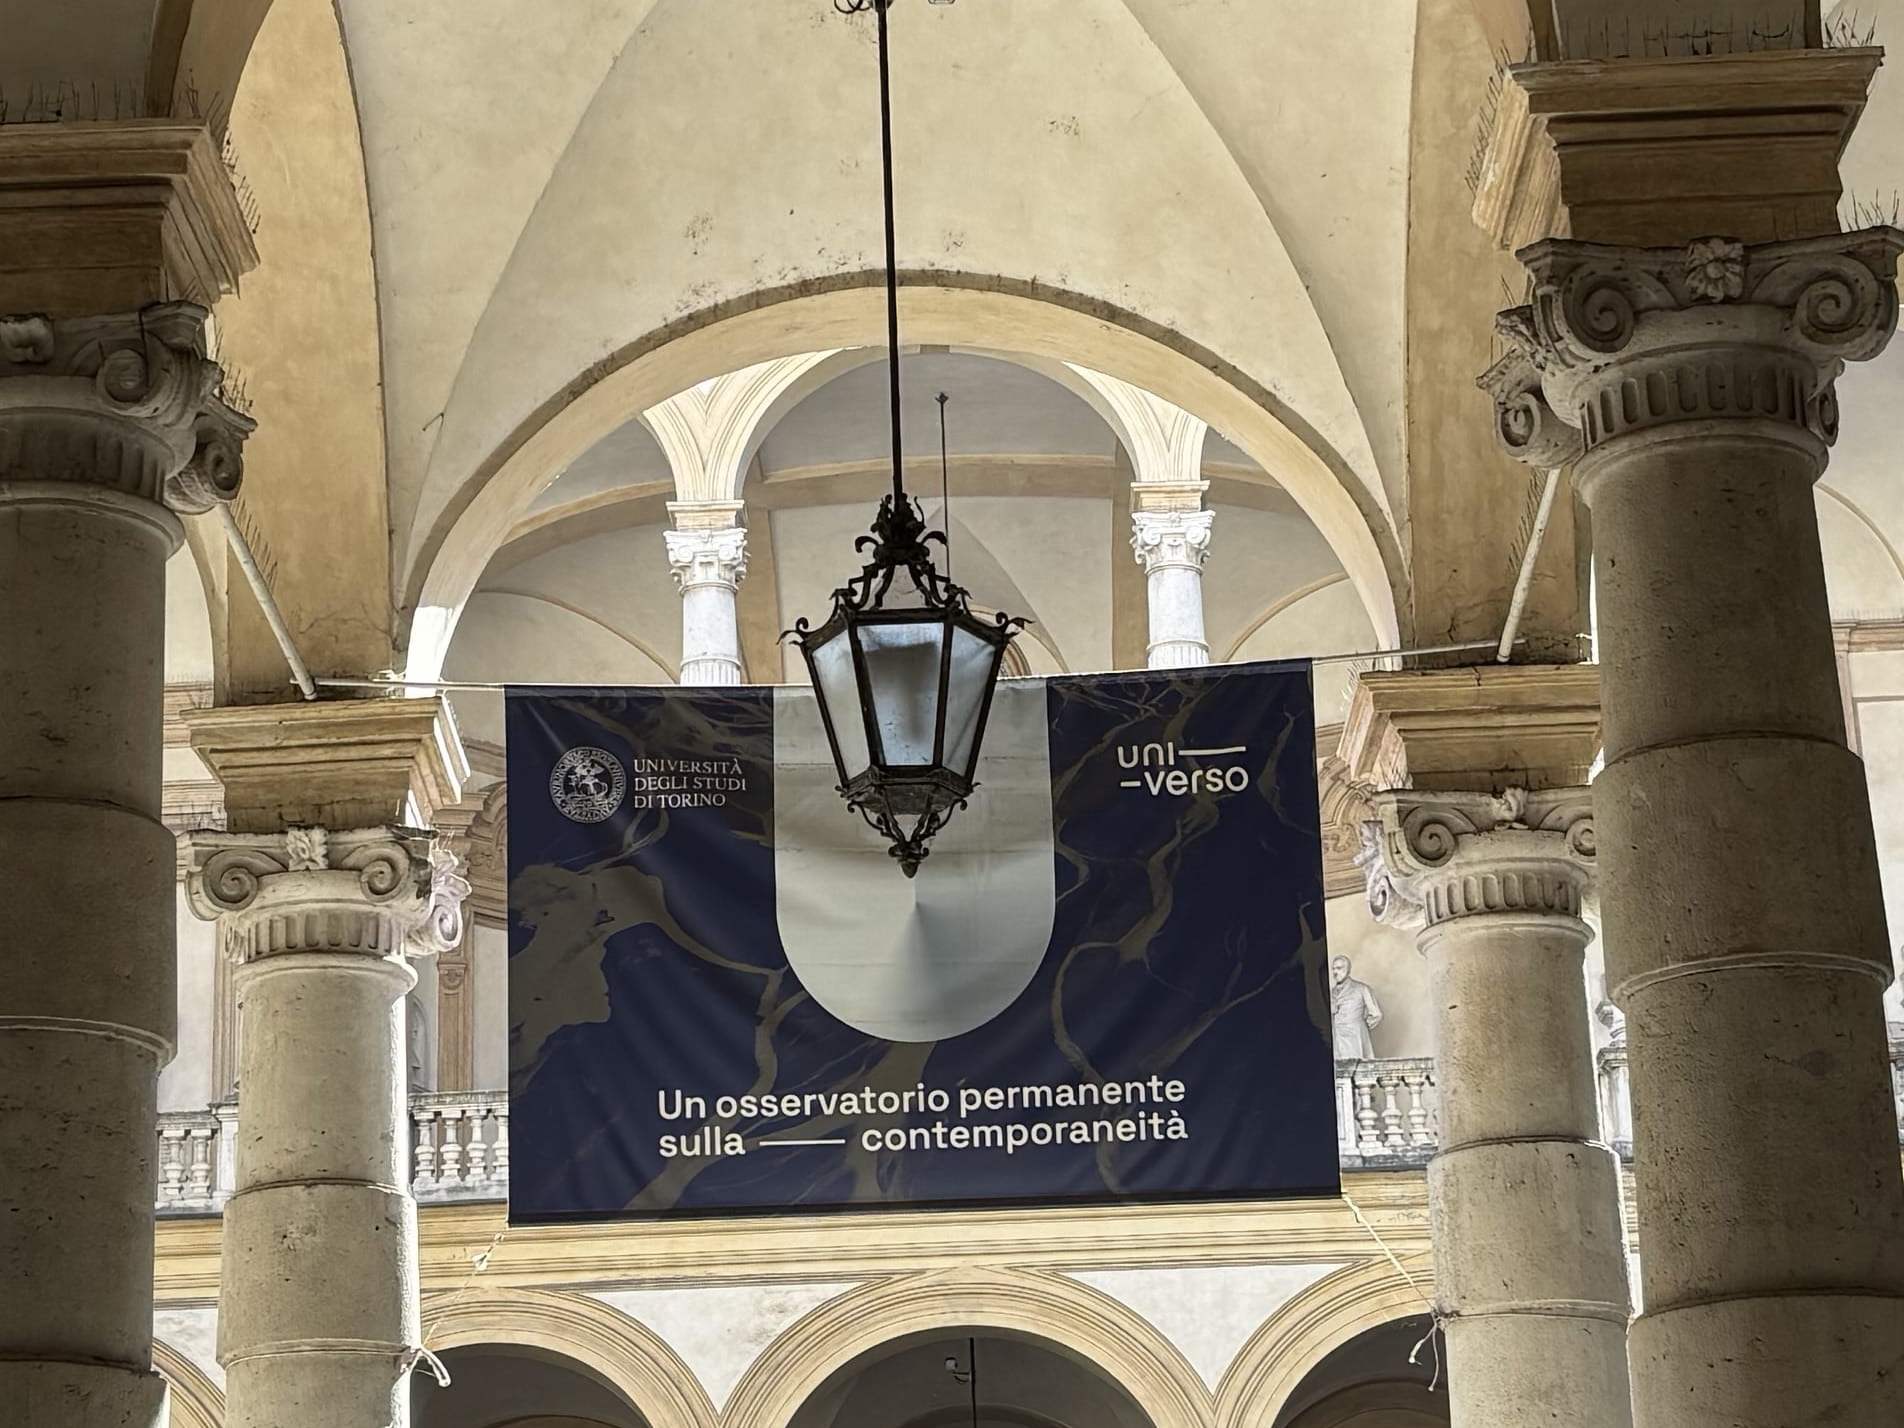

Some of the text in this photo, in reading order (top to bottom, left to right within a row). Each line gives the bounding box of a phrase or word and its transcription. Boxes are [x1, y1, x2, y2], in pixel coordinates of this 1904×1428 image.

[633, 757, 743, 775] UNIVERSITÀ
[634, 776, 746, 791] DEGLI STUDI
[634, 793, 726, 809] DI TORINO
[657, 1075, 1186, 1120] Un osservatorio permanente
[658, 1111, 1188, 1158] sulla contemporaneità
